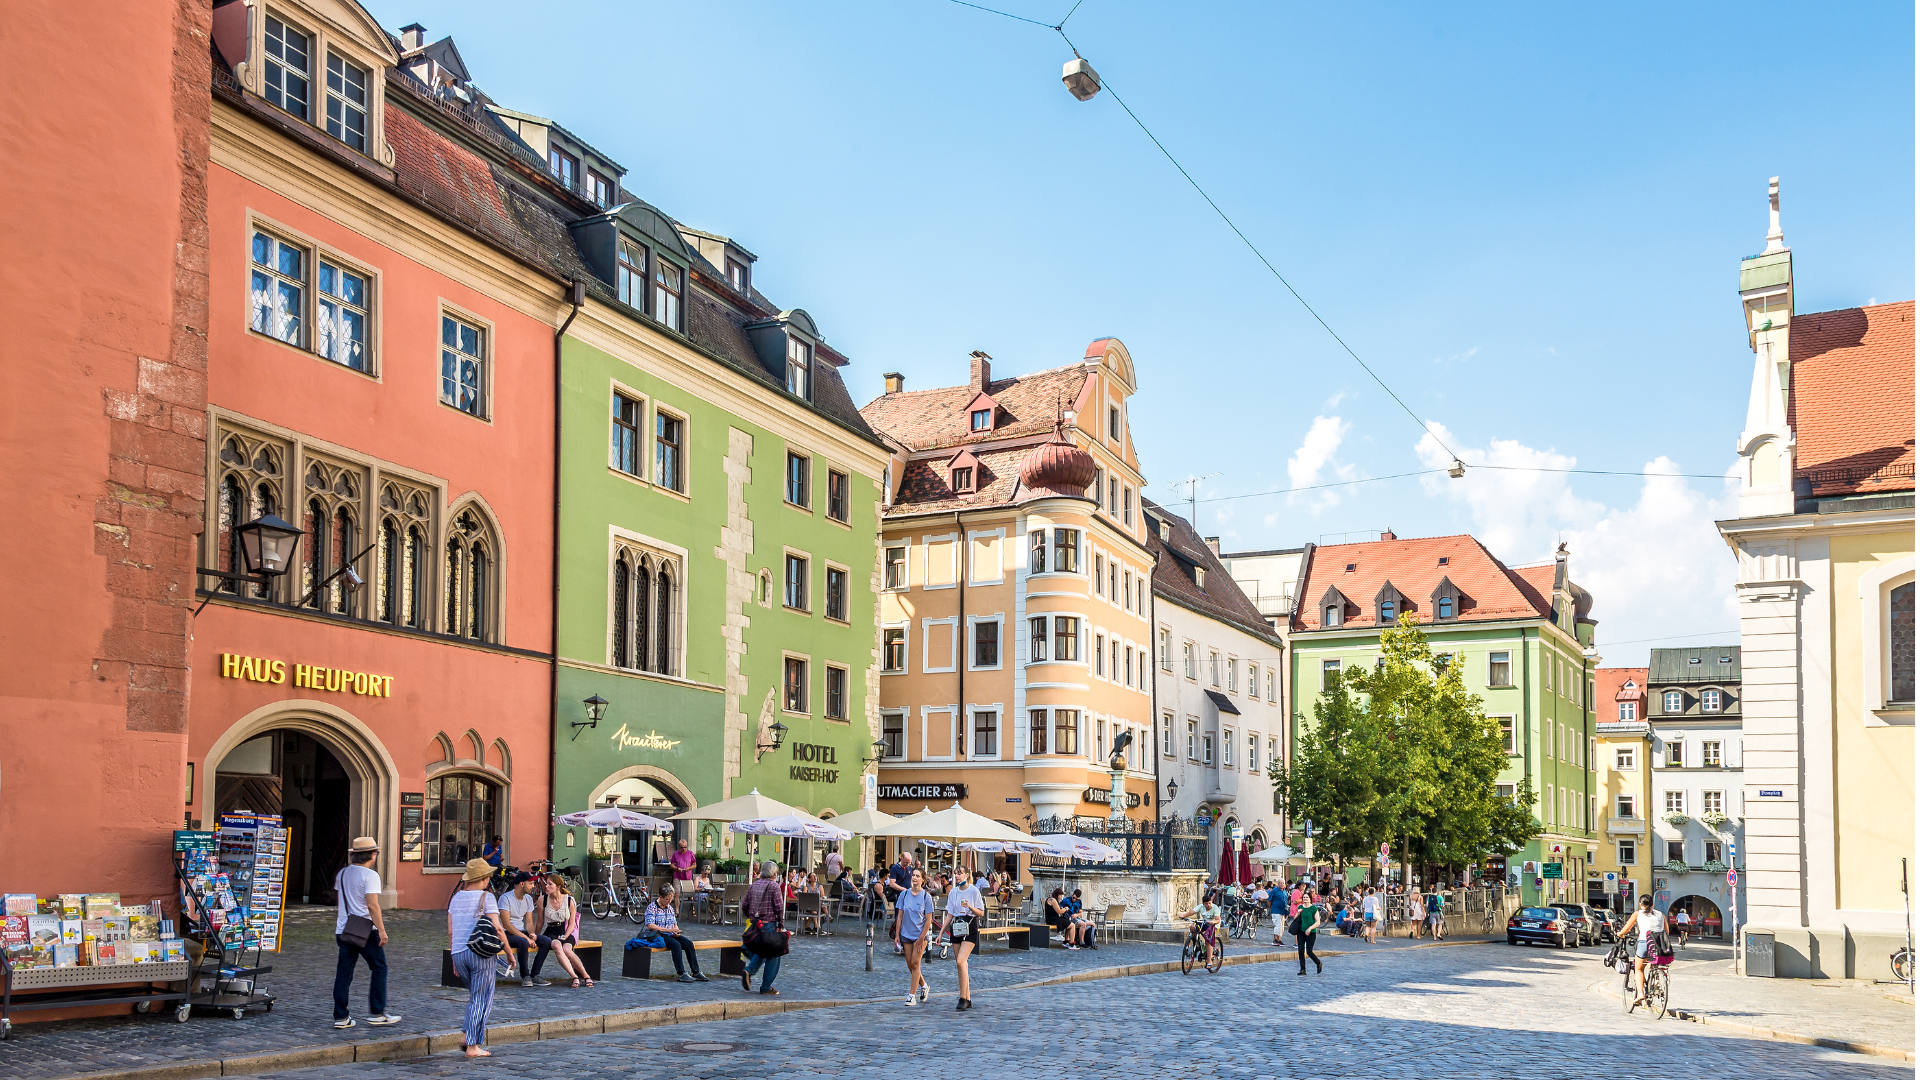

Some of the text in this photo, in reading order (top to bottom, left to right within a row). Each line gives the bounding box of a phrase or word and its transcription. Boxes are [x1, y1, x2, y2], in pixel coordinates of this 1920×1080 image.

[221, 653, 394, 697] HAUS HEUPORT
[793, 742, 838, 764] HOTEL
[790, 765, 839, 783] KAISER-HOF
[877, 786, 941, 797] UTMACHER
